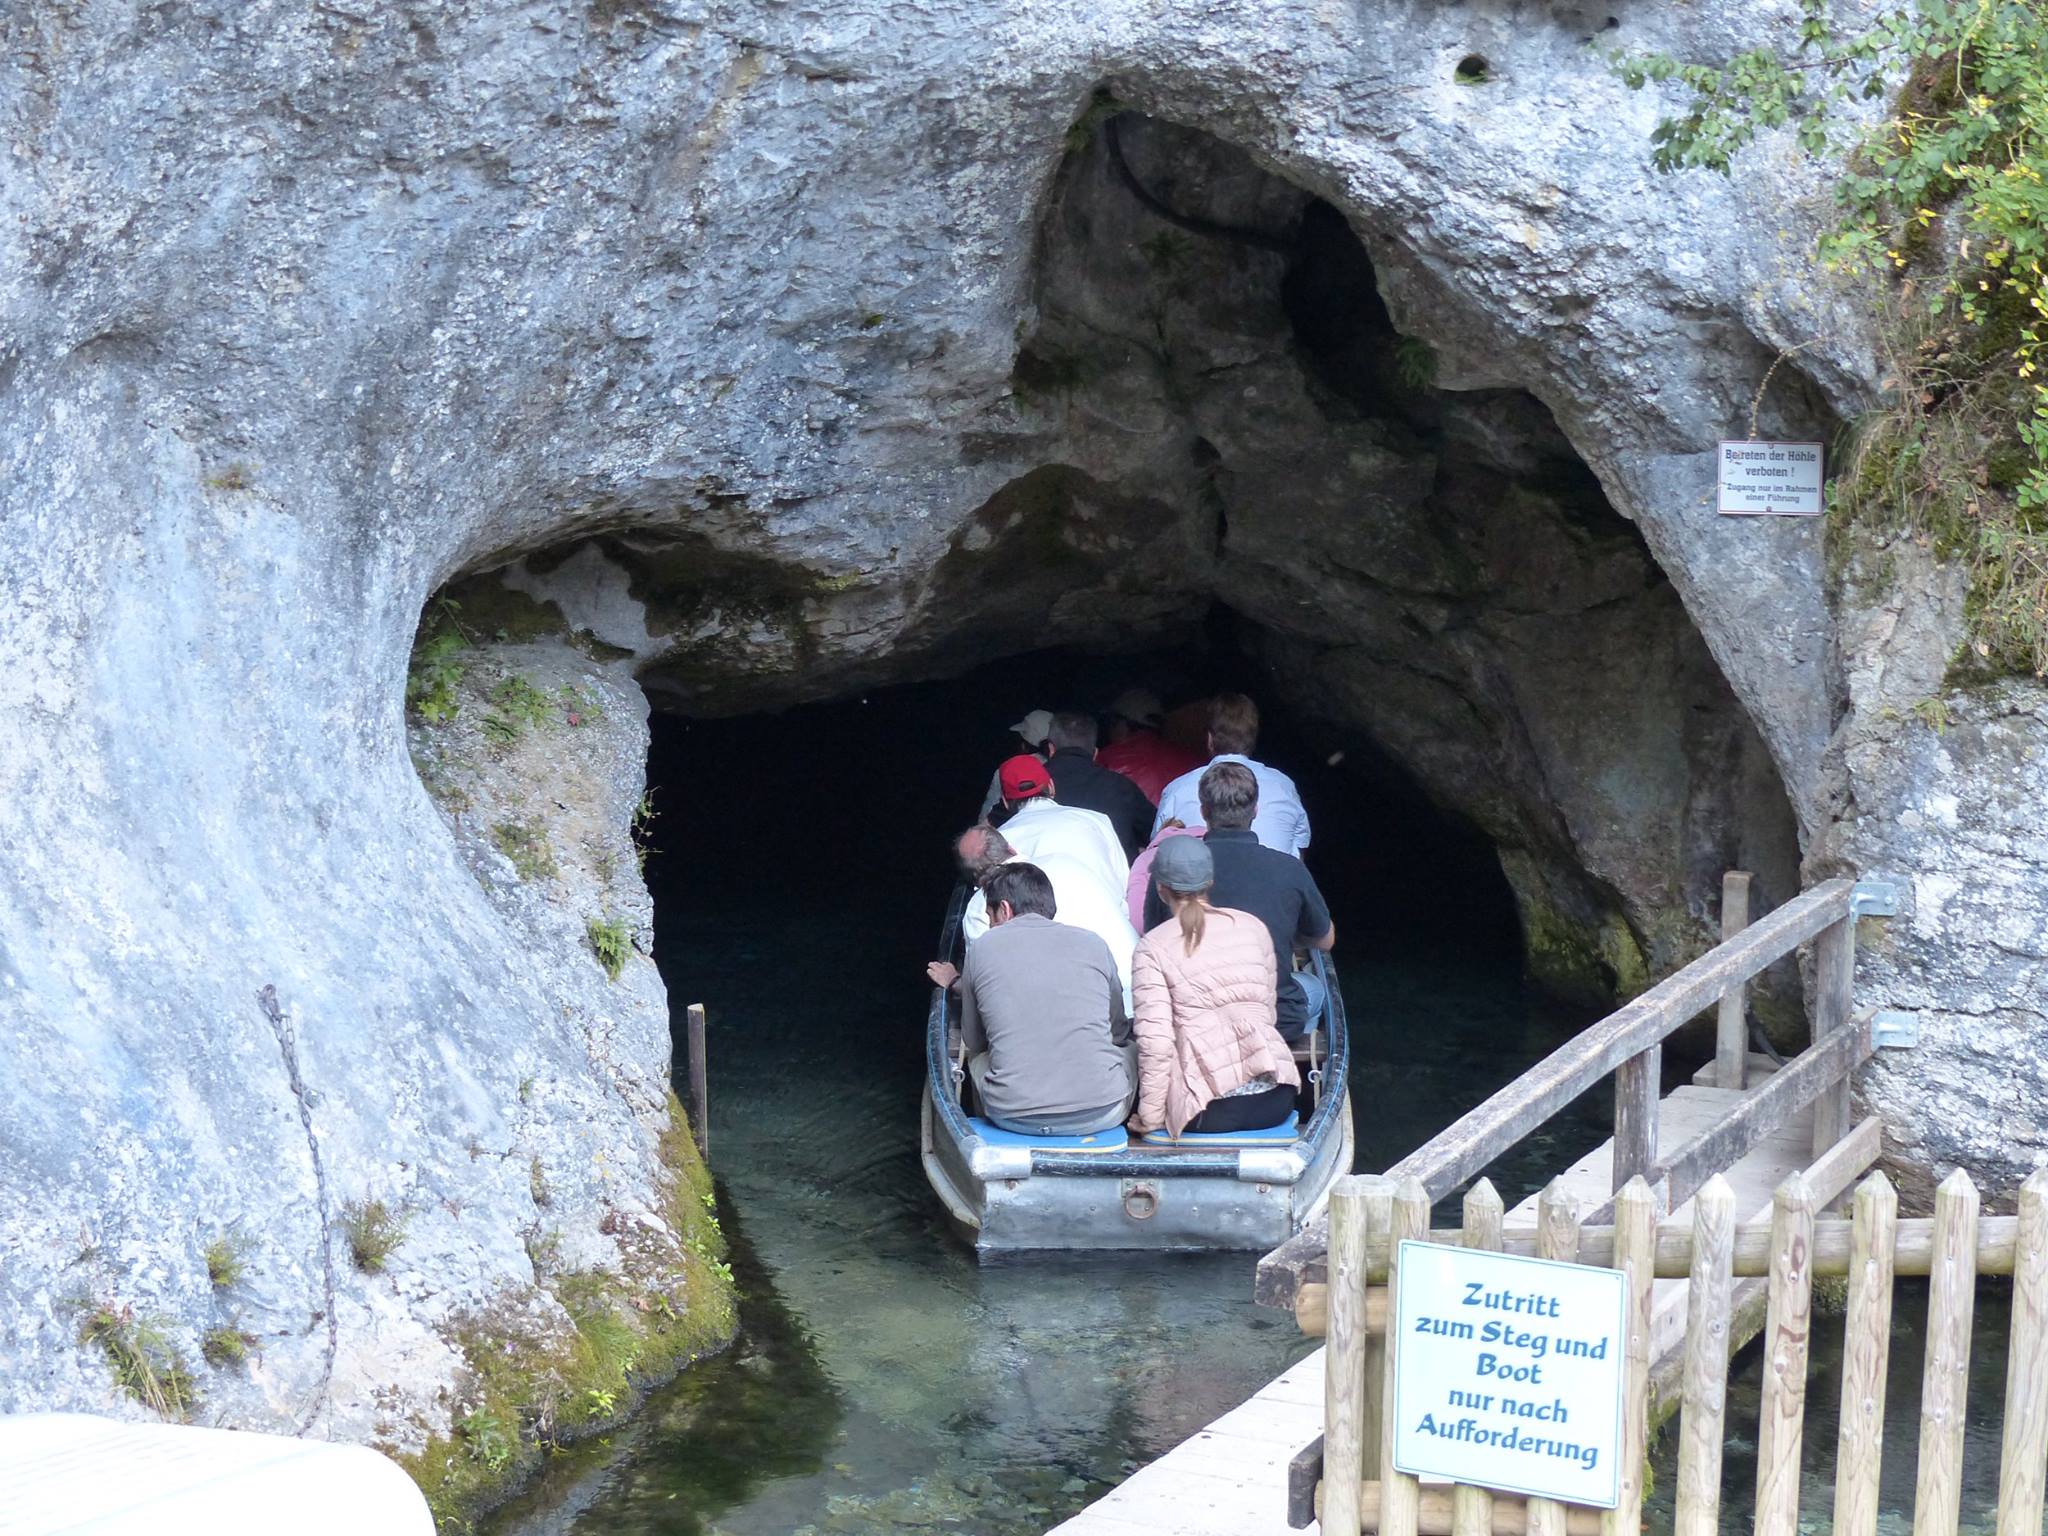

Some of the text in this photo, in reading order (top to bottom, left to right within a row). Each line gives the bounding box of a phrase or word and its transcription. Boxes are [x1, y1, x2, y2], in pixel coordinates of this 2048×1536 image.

[1745, 466, 1788, 477] verboten
[1769, 450, 1785, 461] der
[1788, 450, 1816, 462] Höhle
[1727, 483, 1757, 492] Zugang
[1773, 484, 1783, 492] im
[1786, 485, 1817, 493] Rahmen
[1767, 494, 1800, 503] Führung
[1462, 1283, 1561, 1318] Zutritt
[1415, 1317, 1608, 1360] zum Steg und
[1476, 1353, 1542, 1384] Boot
[1448, 1390, 1568, 1423] nur nach
[1415, 1413, 1599, 1470] Aufforderung
